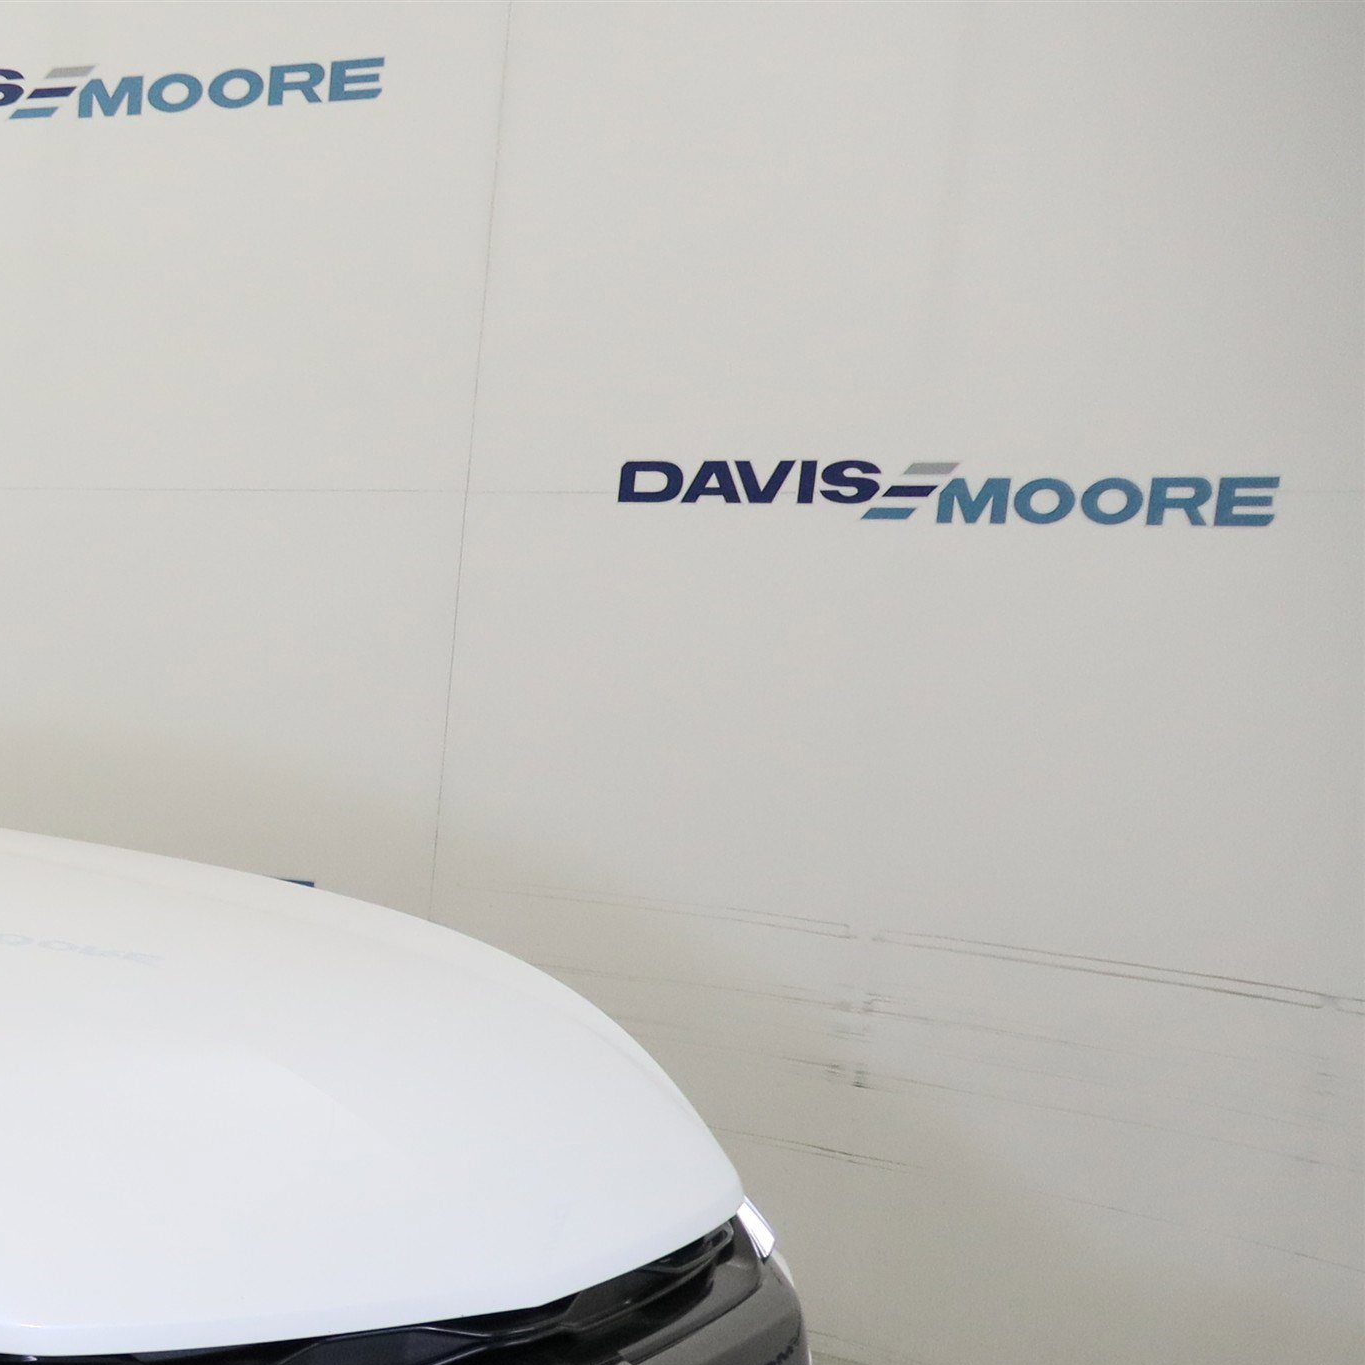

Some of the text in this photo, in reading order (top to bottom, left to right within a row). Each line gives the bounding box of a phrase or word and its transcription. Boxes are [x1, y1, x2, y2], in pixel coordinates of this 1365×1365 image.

[77, 56, 386, 120] MOORE
[617, 459, 1281, 528] DAVIS MOORE
